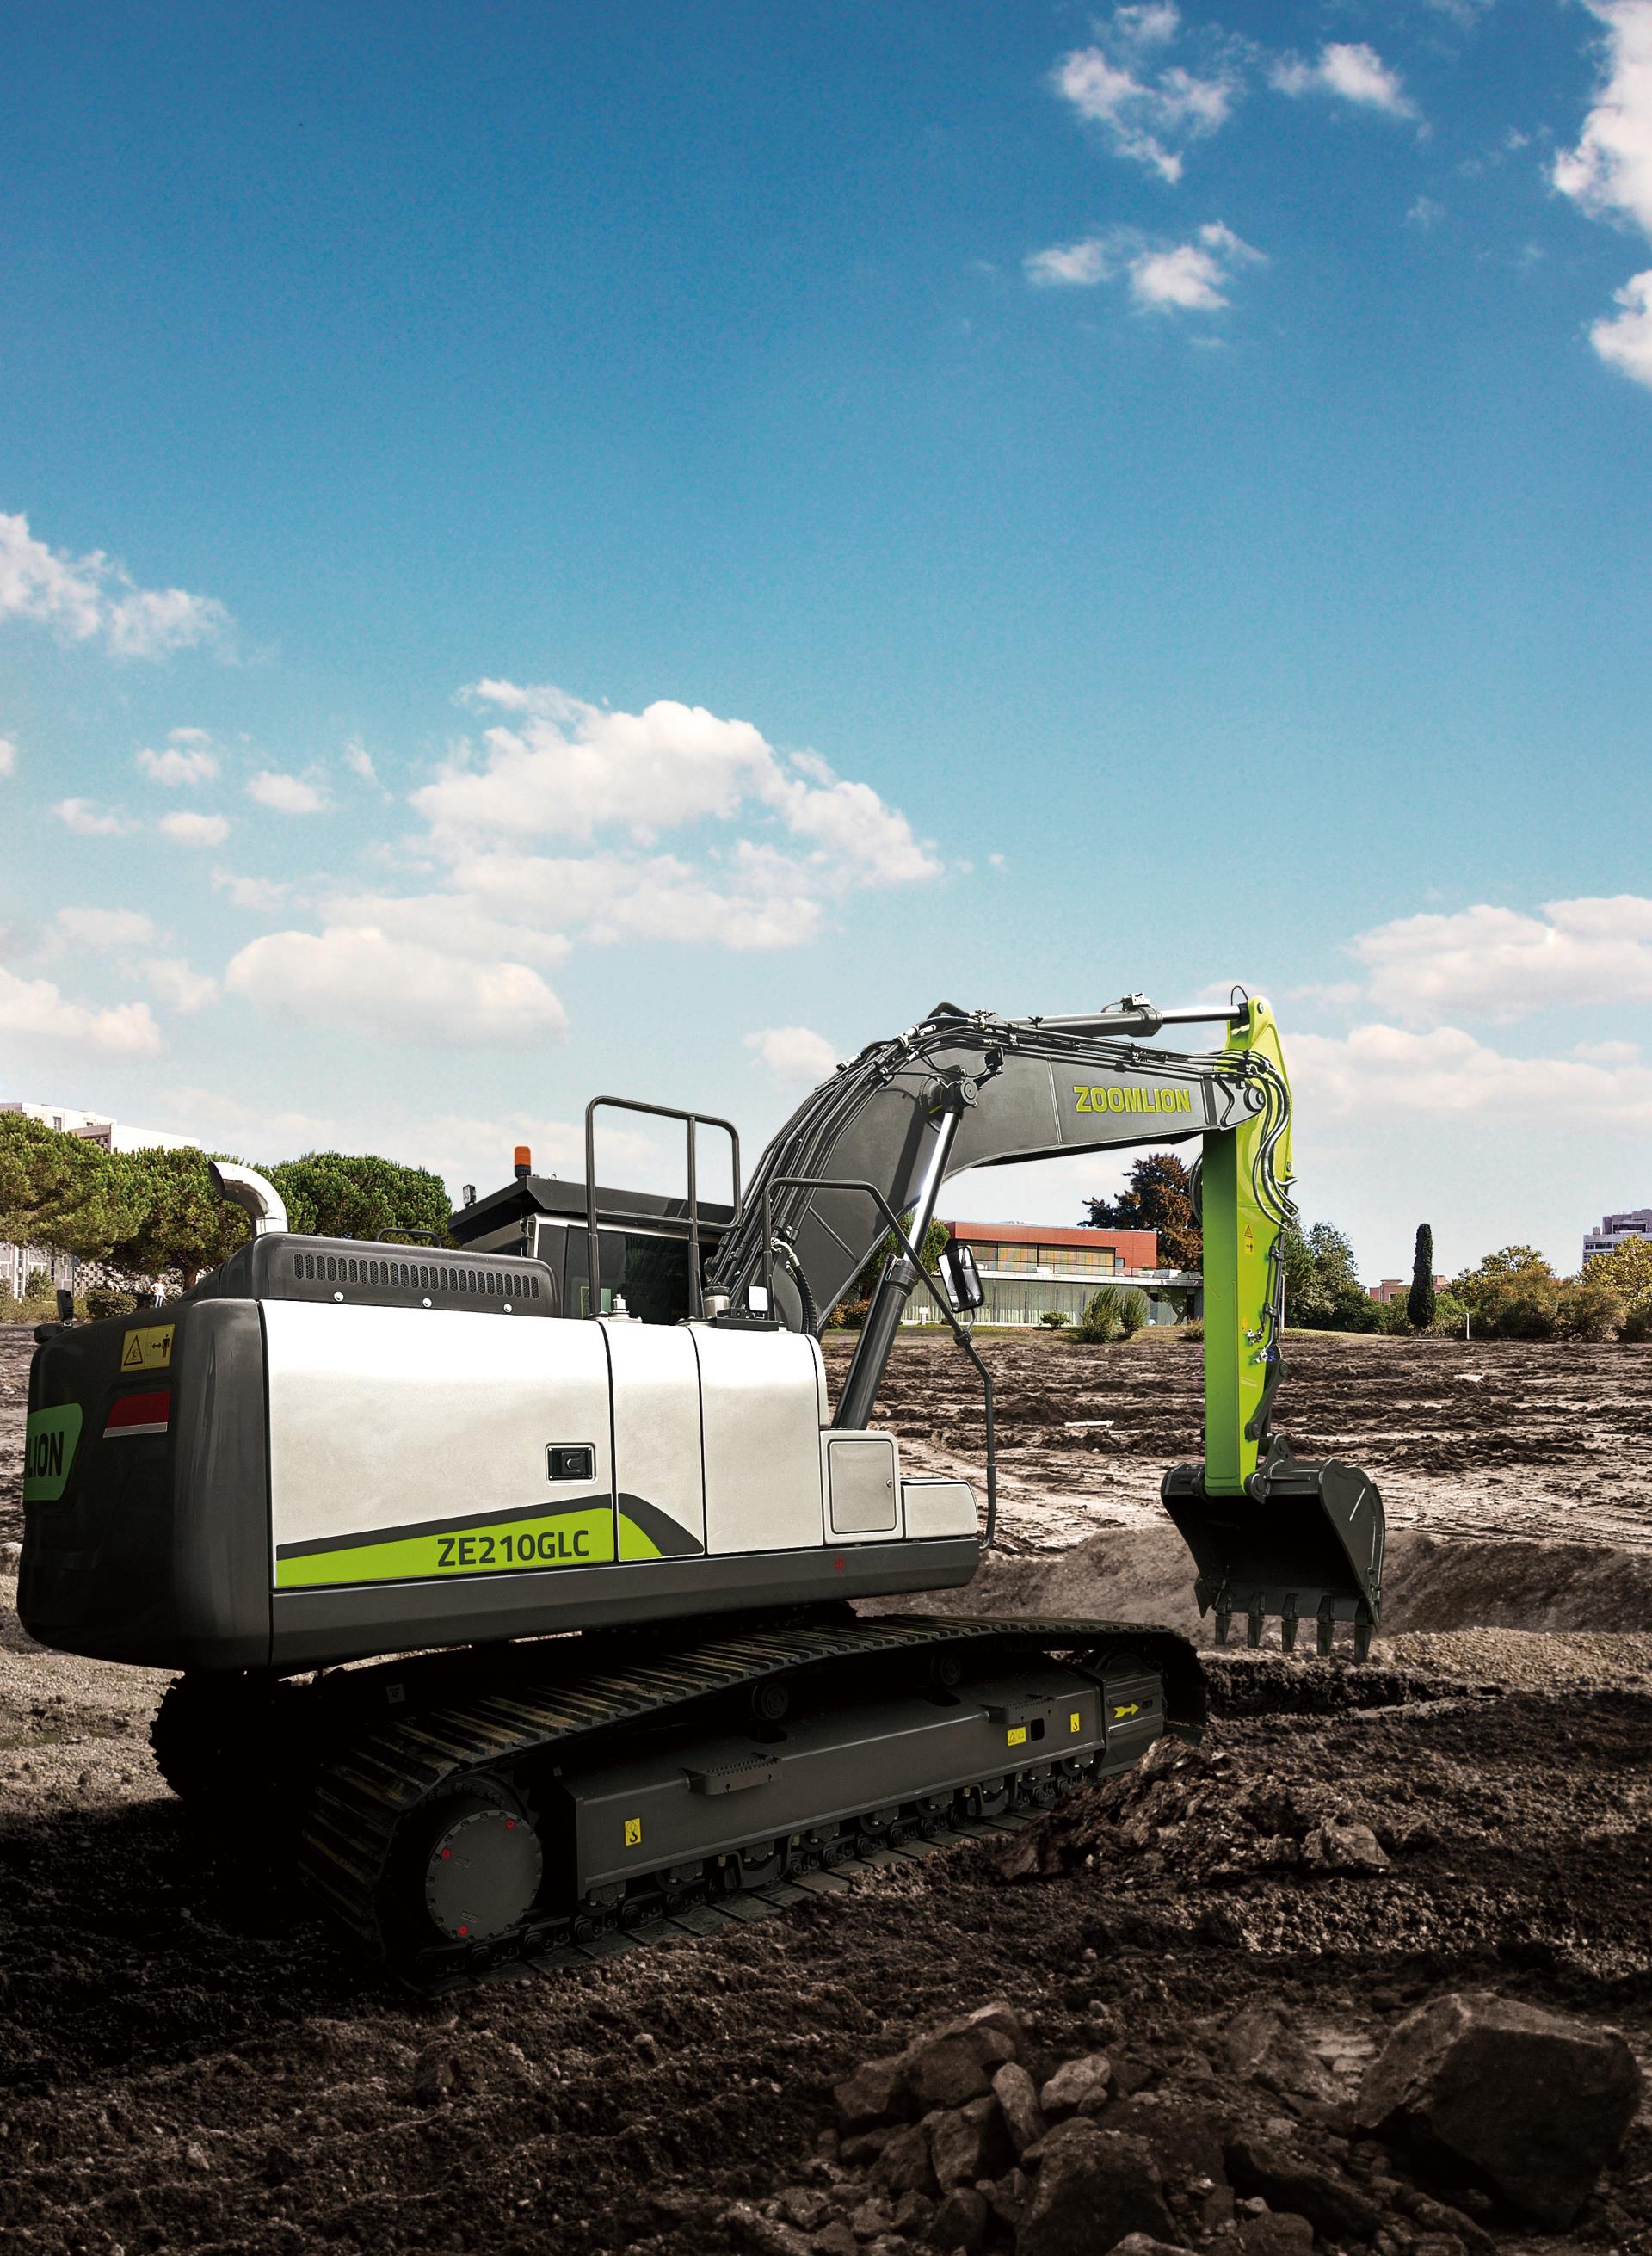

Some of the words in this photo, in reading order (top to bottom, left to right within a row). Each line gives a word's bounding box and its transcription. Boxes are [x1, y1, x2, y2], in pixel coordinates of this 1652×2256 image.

[1073, 1086, 1191, 1113] ZOOMLION
[25, 1431, 65, 1478] LION
[437, 1530, 589, 1567] ZE210GLC
